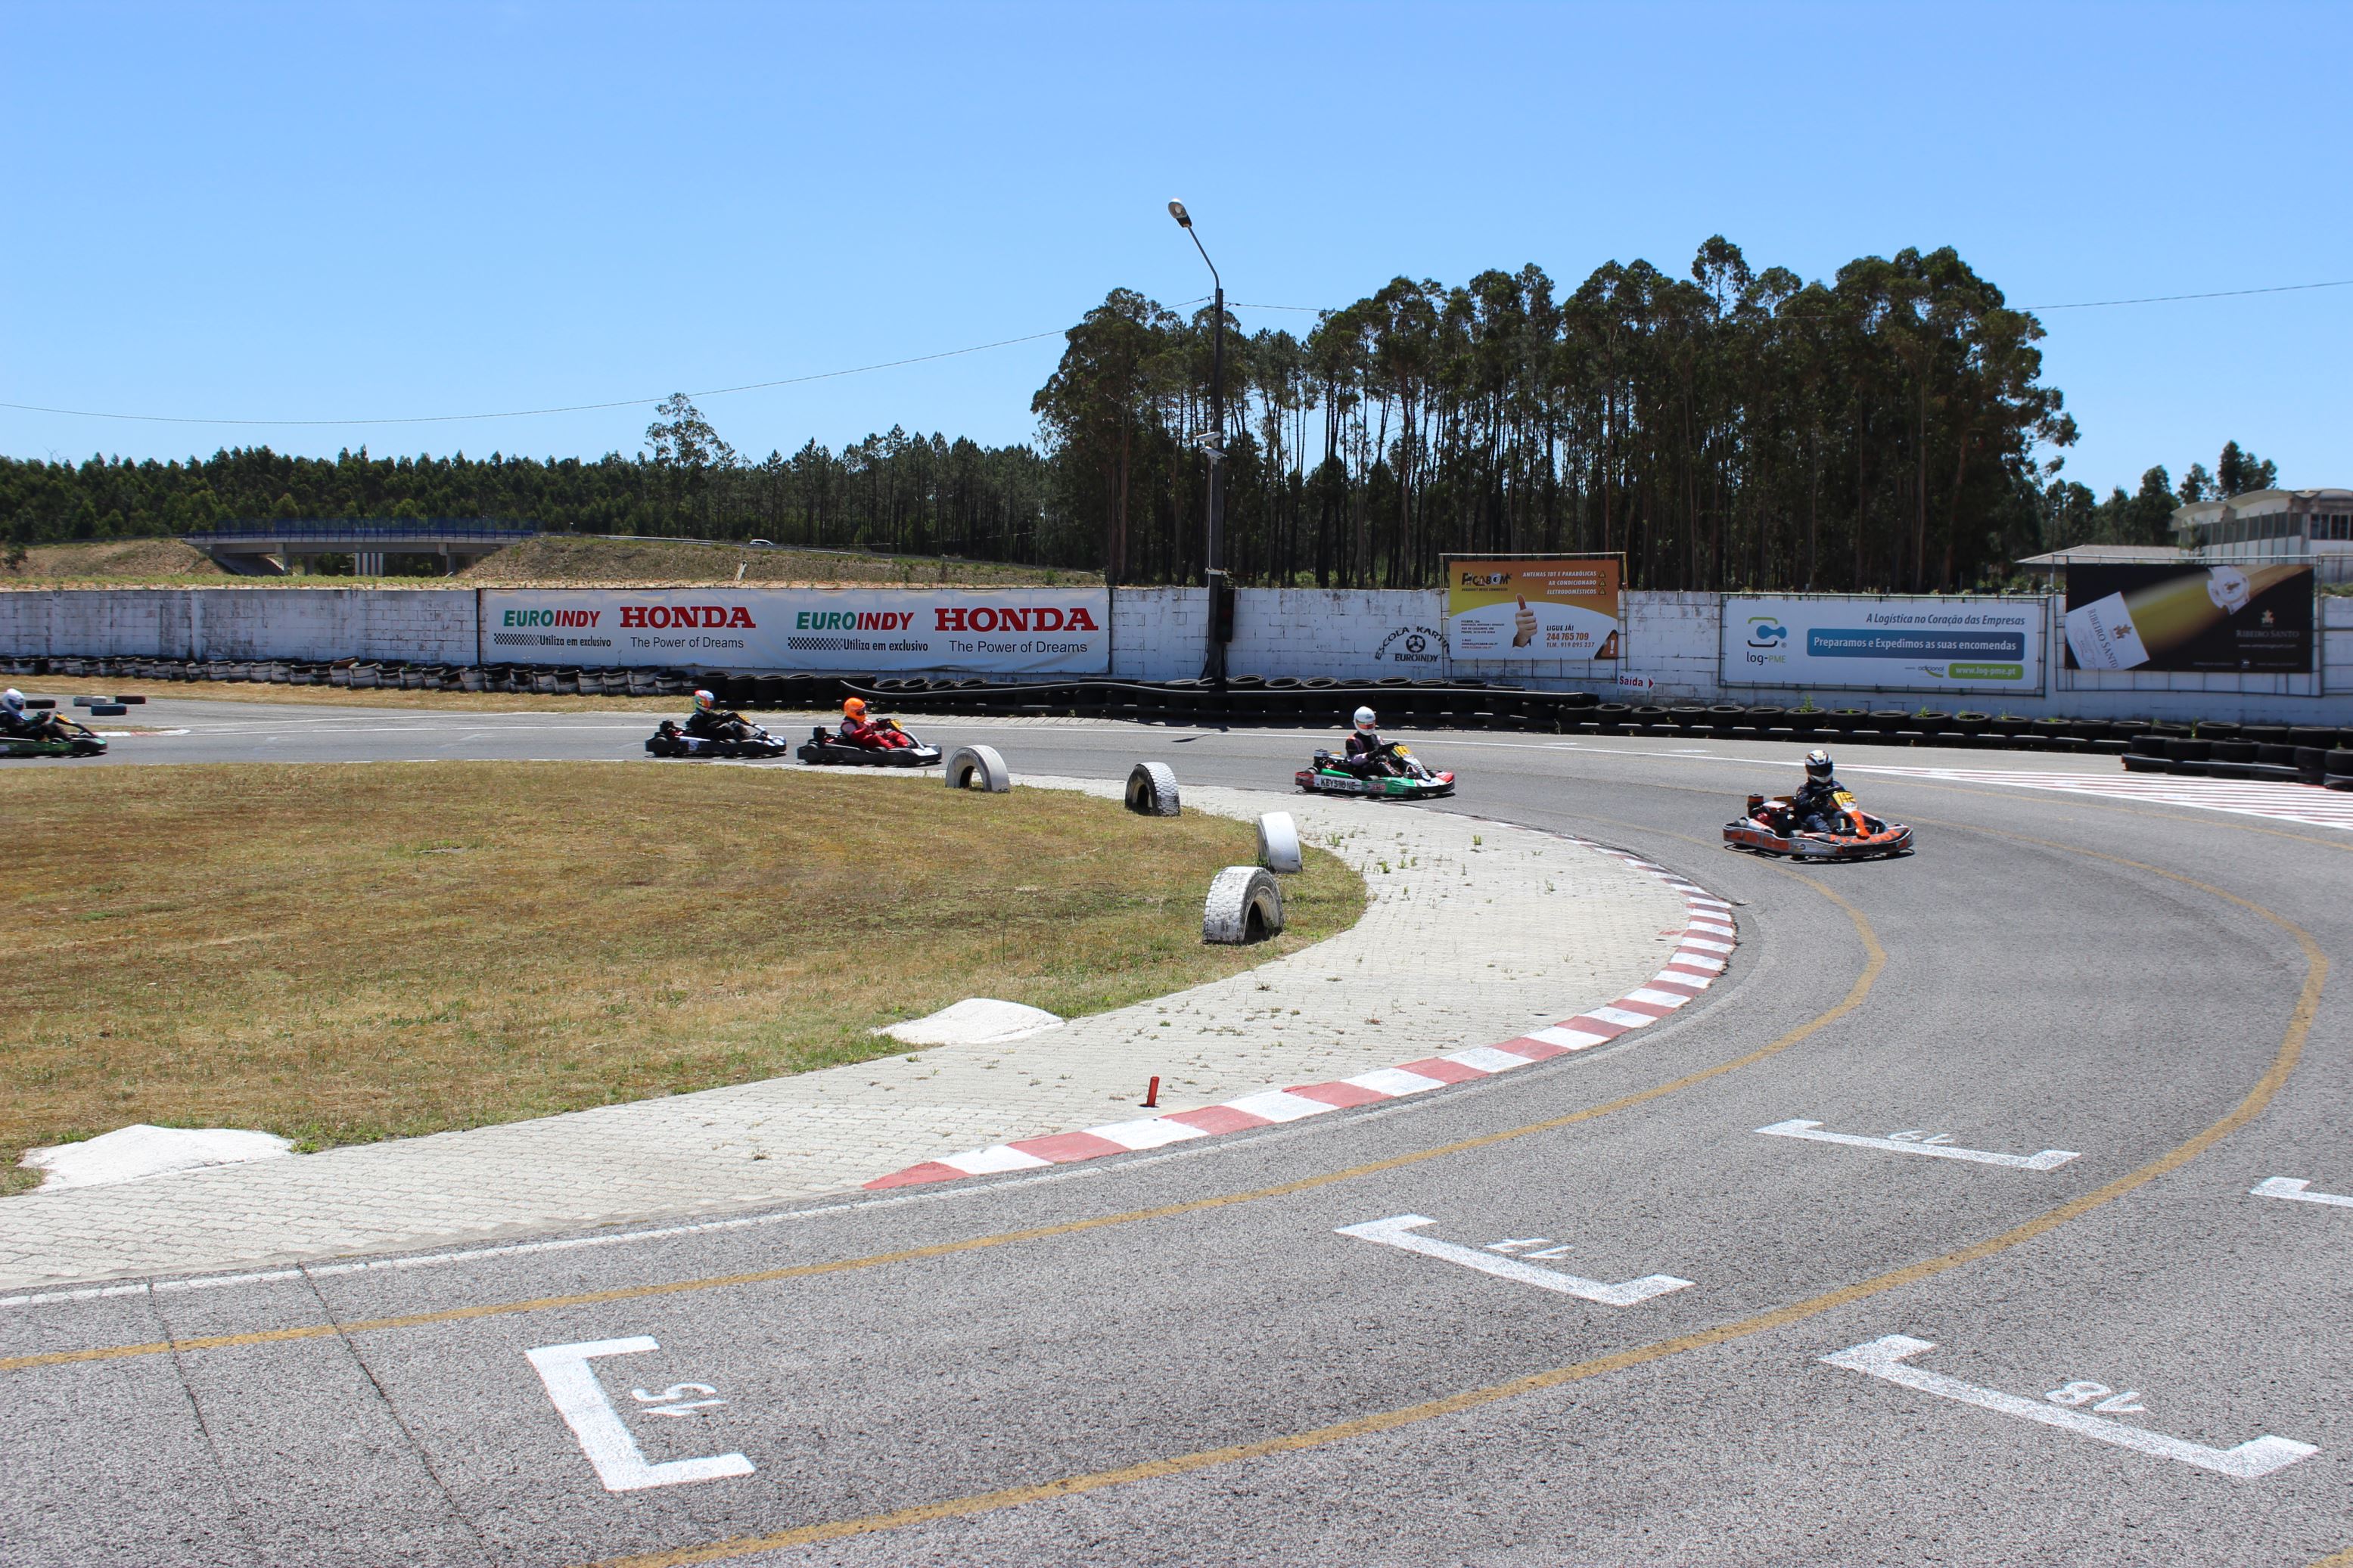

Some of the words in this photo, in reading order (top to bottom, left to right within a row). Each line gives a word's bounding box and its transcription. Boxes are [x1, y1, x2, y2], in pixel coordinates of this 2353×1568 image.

[503, 610, 601, 627] EUROINDY
[620, 606, 757, 629] HONDA
[796, 611, 914, 630] EUROINDY
[934, 607, 1099, 632] HONDA
[1867, 613, 1872, 623] A
[1874, 614, 1912, 626] Logística
[1915, 616, 1926, 624] no
[1927, 614, 1961, 626] Coração
[1964, 615, 1979, 625] das
[1982, 616, 2025, 626] Empresas
[539, 635, 564, 646] Utiliza
[567, 638, 578, 646] em
[580, 635, 611, 647] exclusivo
[631, 636, 650, 647] The
[654, 637, 685, 647] Power
[688, 636, 700, 647] of
[704, 637, 744, 648] Dreams
[1375, 627, 1410, 660] ESCOLA
[1416, 626, 1450, 654] KARTIN
[1546, 632, 1560, 641] 244
[1562, 632, 1574, 641] 765
[1576, 632, 1590, 641] 709
[2087, 608, 2106, 641] RIBEIRO
[2101, 642, 2118, 668] SANTO
[844, 638, 870, 650] Utiliza
[872, 641, 887, 651] em
[889, 639, 928, 651] exclusivo
[950, 640, 974, 652] The
[978, 641, 1017, 652] Power
[1021, 641, 1032, 652] of
[1037, 641, 1088, 653] Dreams
[1814, 637, 1866, 650] Preparamos
[1876, 638, 1922, 650] Expedimos
[1959, 640, 2016, 651] encomendas
[1395, 654, 1438, 662] EUROINDY
[1954, 666, 2016, 677] www.log-pme.pt
[1619, 675, 1643, 687] Saída
[1888, 1130, 1954, 1143] 19
[631, 1383, 728, 1417] 15
[2046, 1381, 2145, 1411] 18
